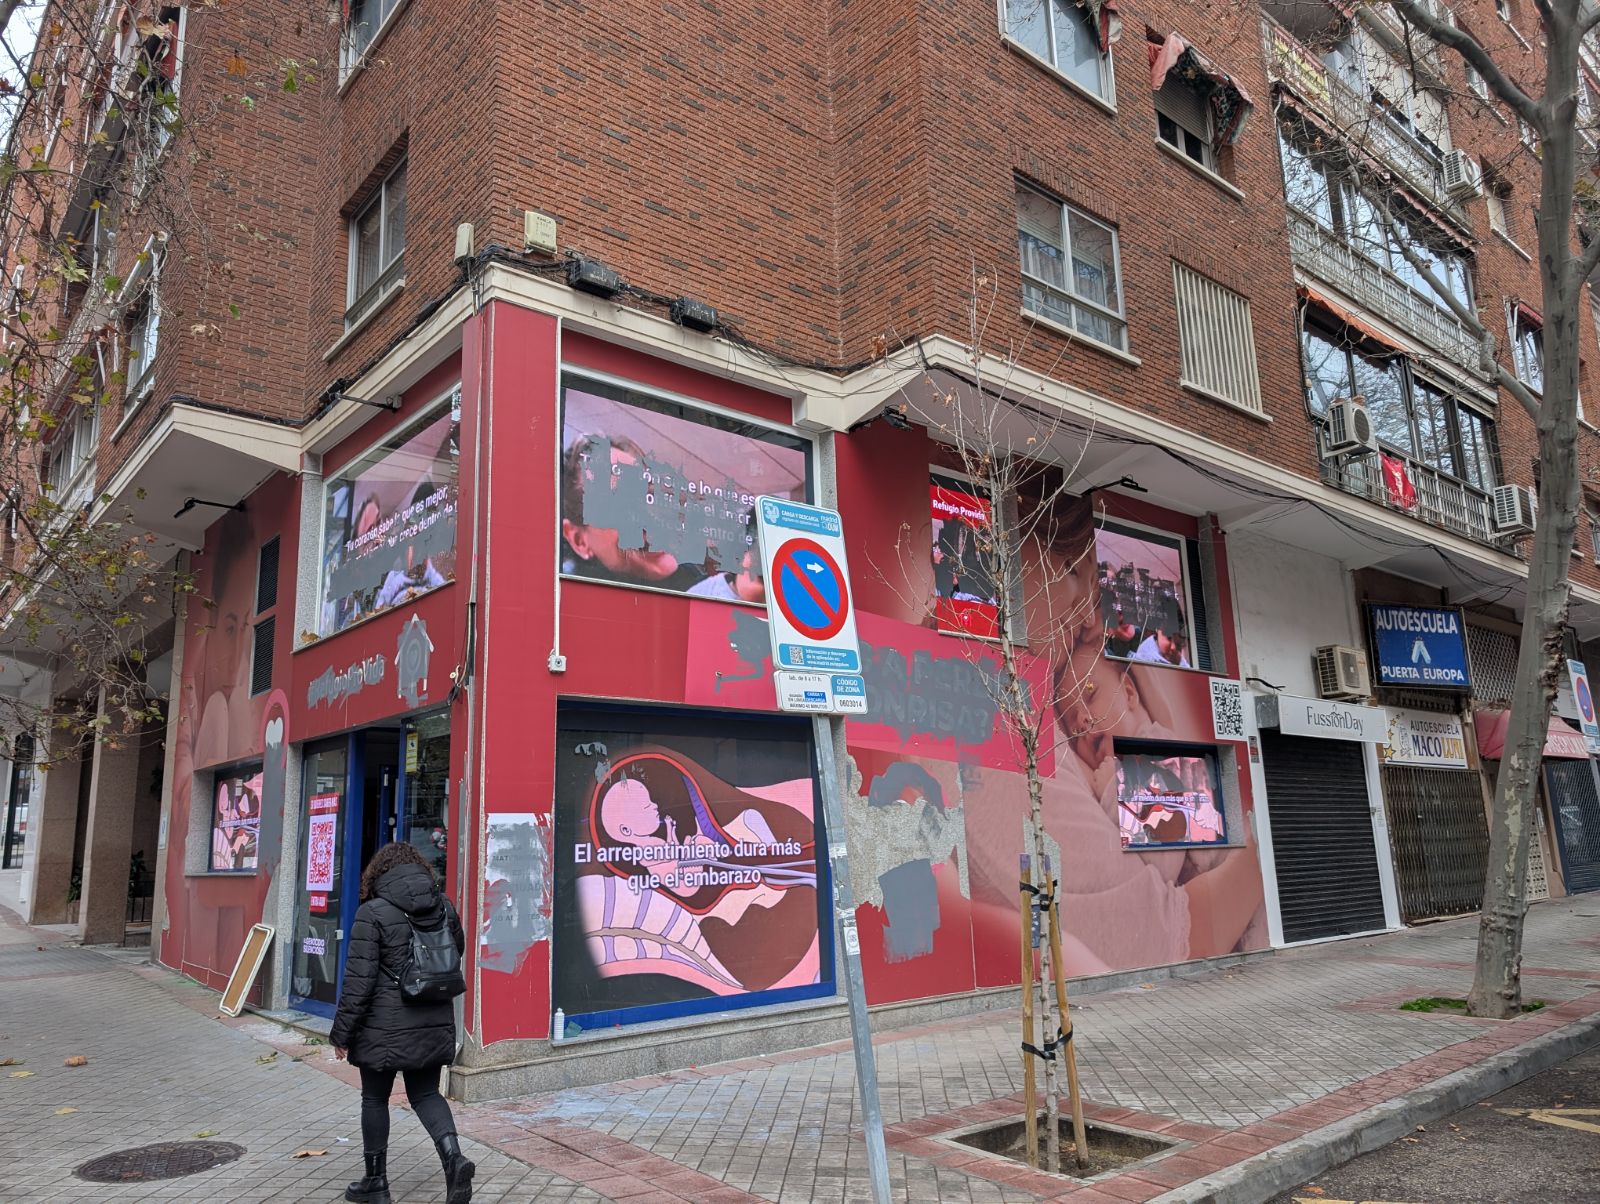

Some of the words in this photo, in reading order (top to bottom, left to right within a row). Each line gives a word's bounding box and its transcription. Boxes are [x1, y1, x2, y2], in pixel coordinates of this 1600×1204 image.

[1376, 608, 1458, 634] AUTOESCUELA
[1381, 665, 1420, 679] PUERTA
[1422, 667, 1465, 681] EUROPA
[836, 678, 858, 686] CÓDIGO
[836, 685, 845, 693] DE
[1410, 719, 1460, 736] AUTOESCUELA
[574, 842, 592, 863] El
[597, 840, 730, 865] arrepentimiento
[732, 838, 767, 859] dura
[774, 838, 802, 857] más
[627, 871, 660, 895] que
[664, 869, 679, 888] el
[681, 867, 762, 887] embarazo
